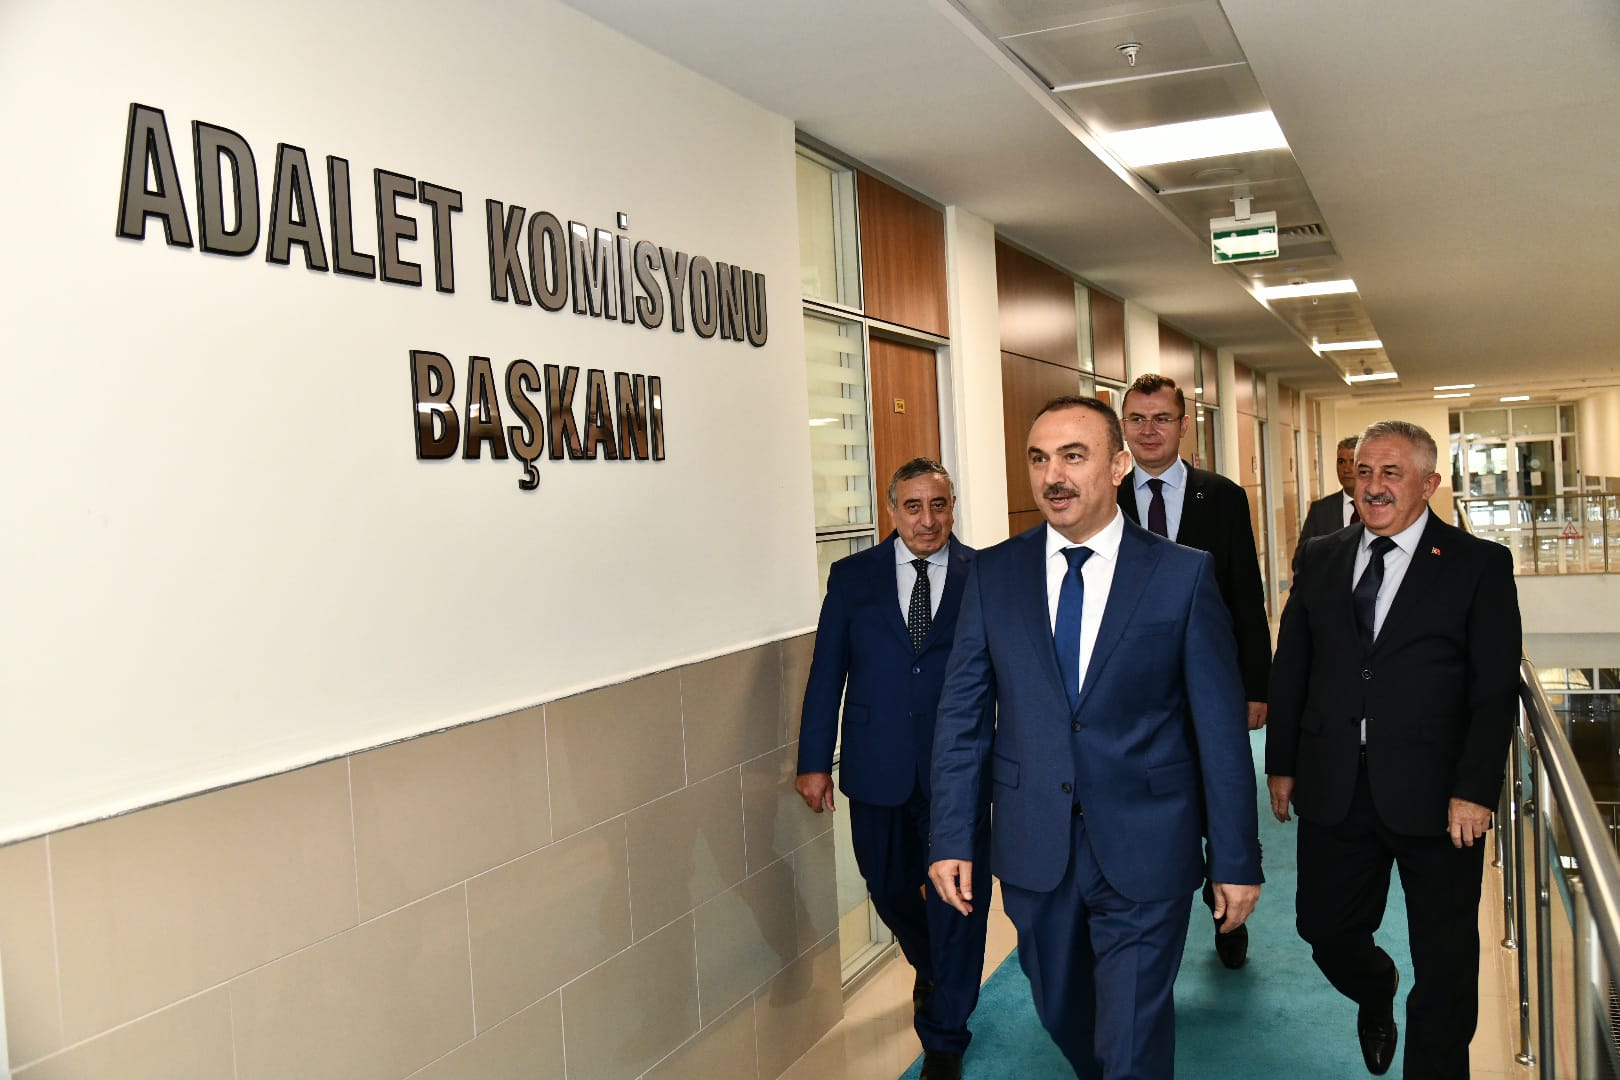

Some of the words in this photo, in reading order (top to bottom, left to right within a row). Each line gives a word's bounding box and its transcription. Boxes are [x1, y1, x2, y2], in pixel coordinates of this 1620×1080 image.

[116, 102, 463, 293] ADALET
[485, 198, 768, 346] KOMİSYONU
[410, 349, 665, 490] BAŞKANI
